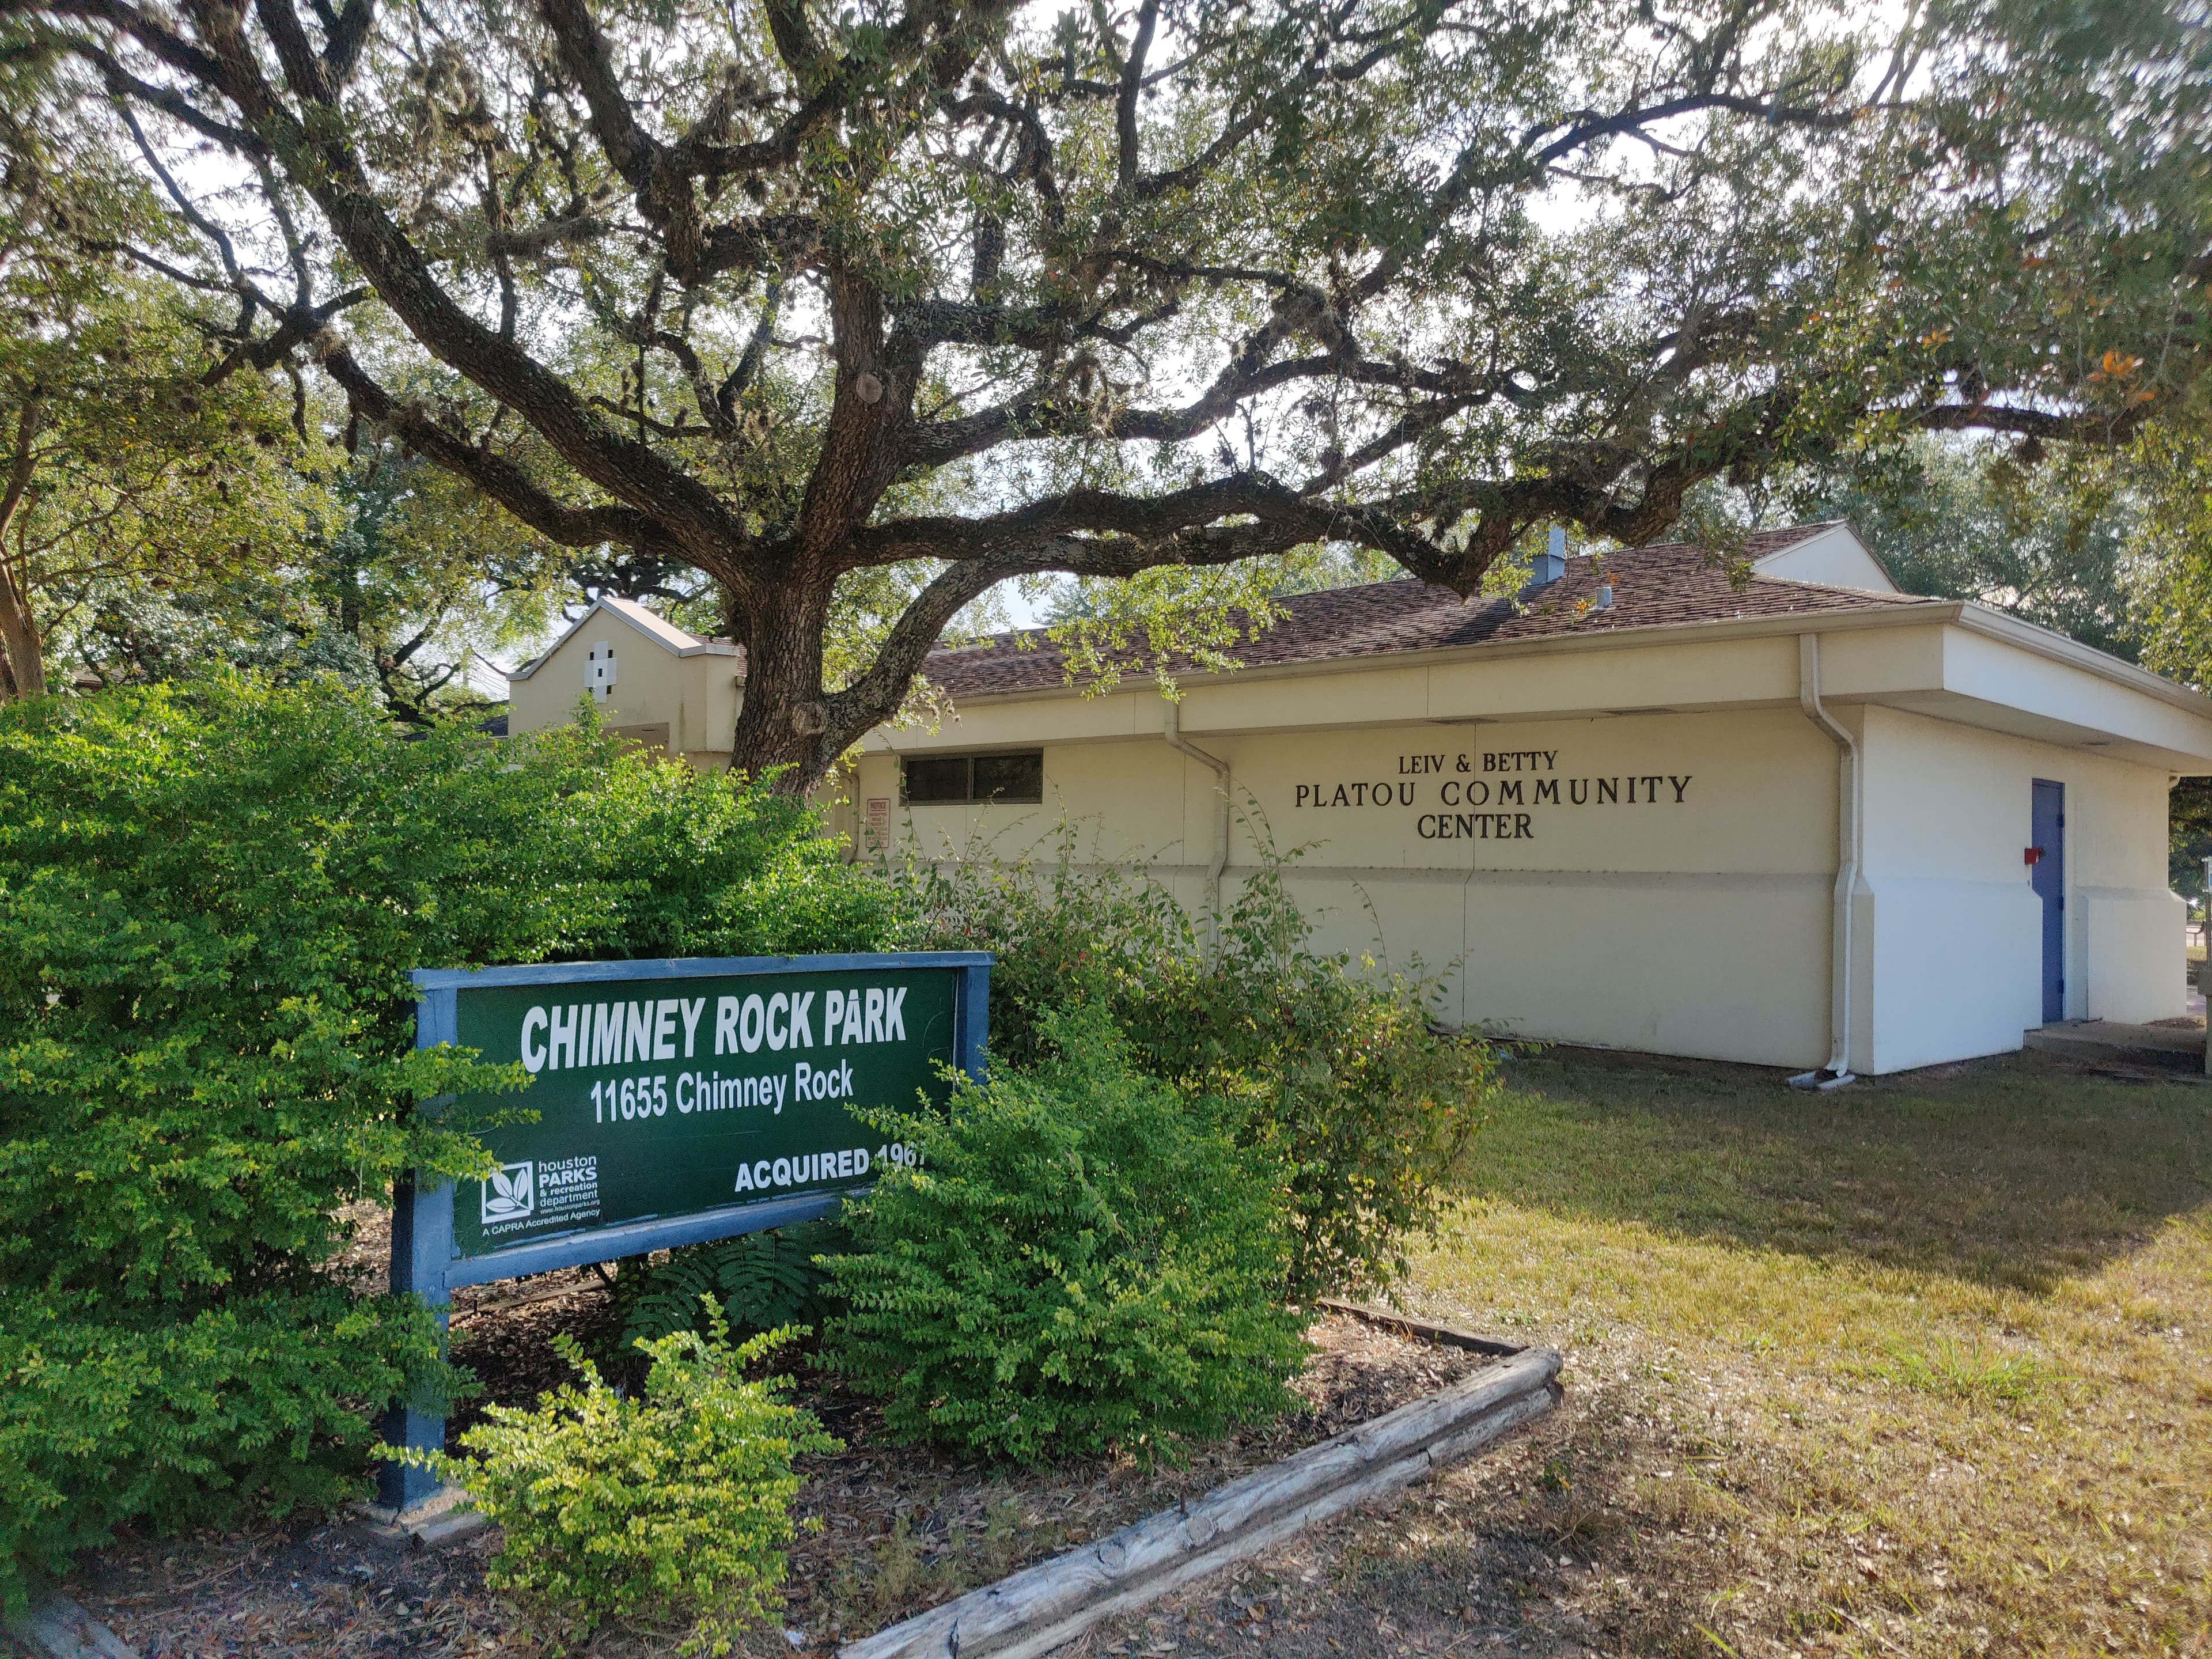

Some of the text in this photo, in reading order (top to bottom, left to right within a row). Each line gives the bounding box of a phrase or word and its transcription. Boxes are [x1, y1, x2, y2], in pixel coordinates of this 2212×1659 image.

[1398, 750, 1559, 774] LEIV & BETTY
[1295, 775, 1694, 808] PLATOU COMMUNITY
[870, 801, 887, 809] NOTICE
[1417, 813, 1535, 839] CENTER
[521, 986, 908, 1073] CHIMNEY ROCK PARK
[590, 1059, 853, 1123] 11655 Chimney Rock
[539, 1156, 597, 1173] houston
[734, 1148, 870, 1192] ACQUIRED
[539, 1166, 598, 1188] PARKS
[540, 1182, 598, 1198] & recreation
[540, 1189, 599, 1207] department
[540, 1199, 600, 1215] www.houstonparks.org
[482, 1209, 600, 1237] A CAPRA Accredited Agency
